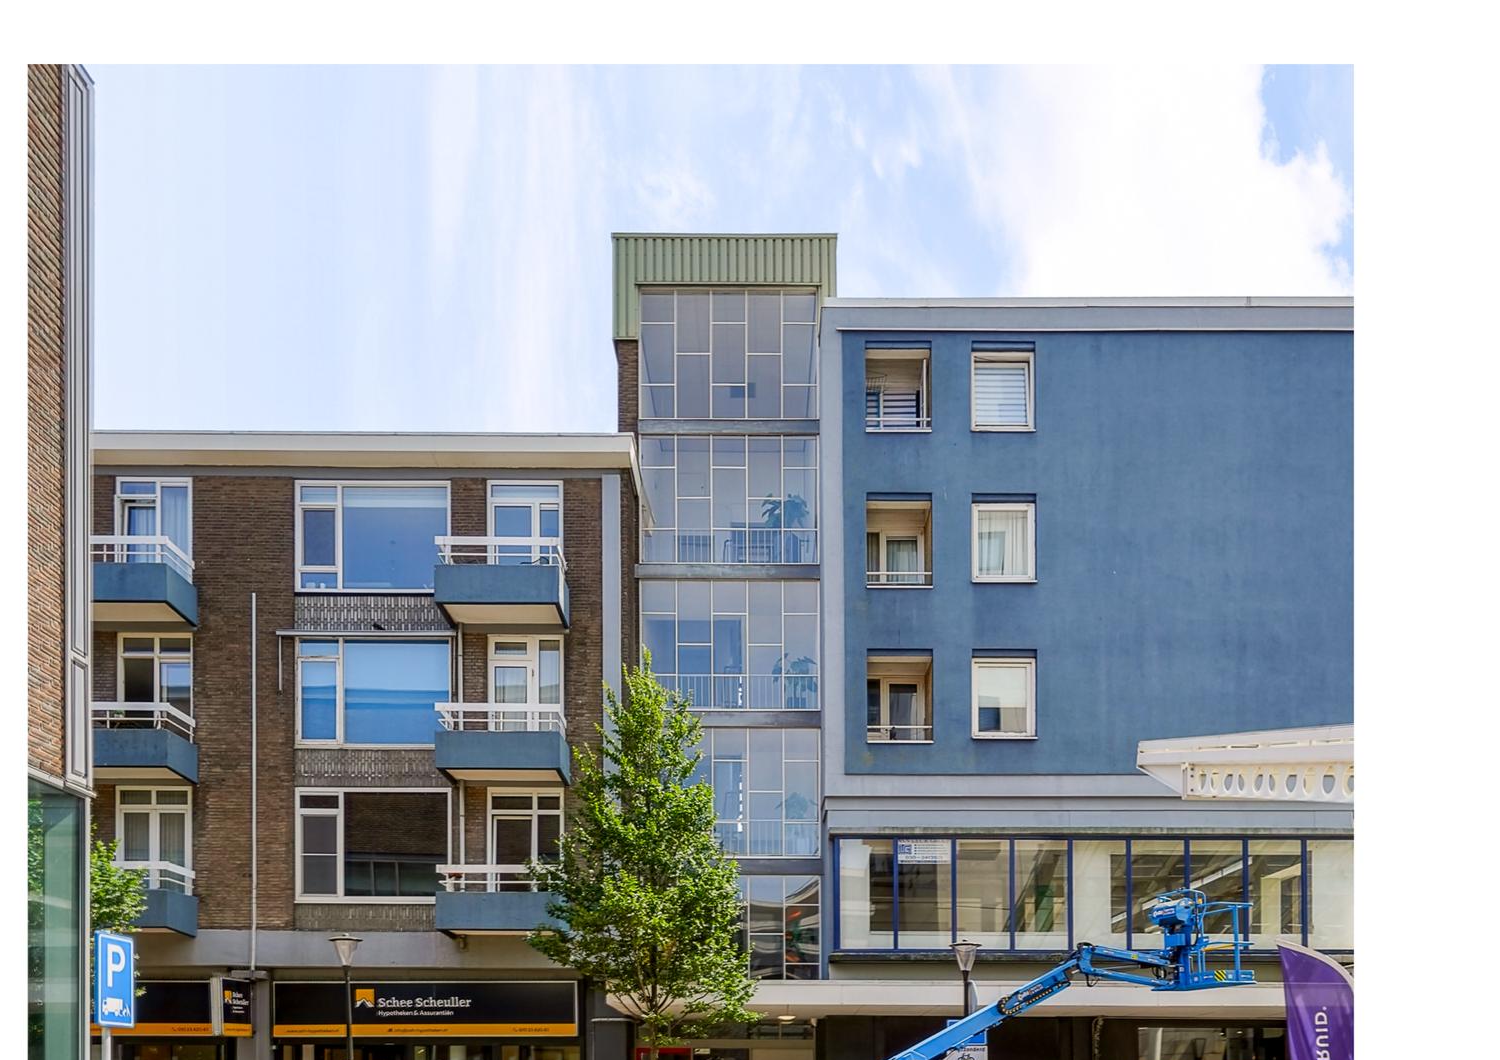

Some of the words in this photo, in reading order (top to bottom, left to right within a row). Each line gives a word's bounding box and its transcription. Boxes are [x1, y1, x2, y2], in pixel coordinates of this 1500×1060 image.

[107, 943, 125, 988] P
[377, 997, 413, 1008] Schee
[415, 996, 472, 1008] Scheuller
